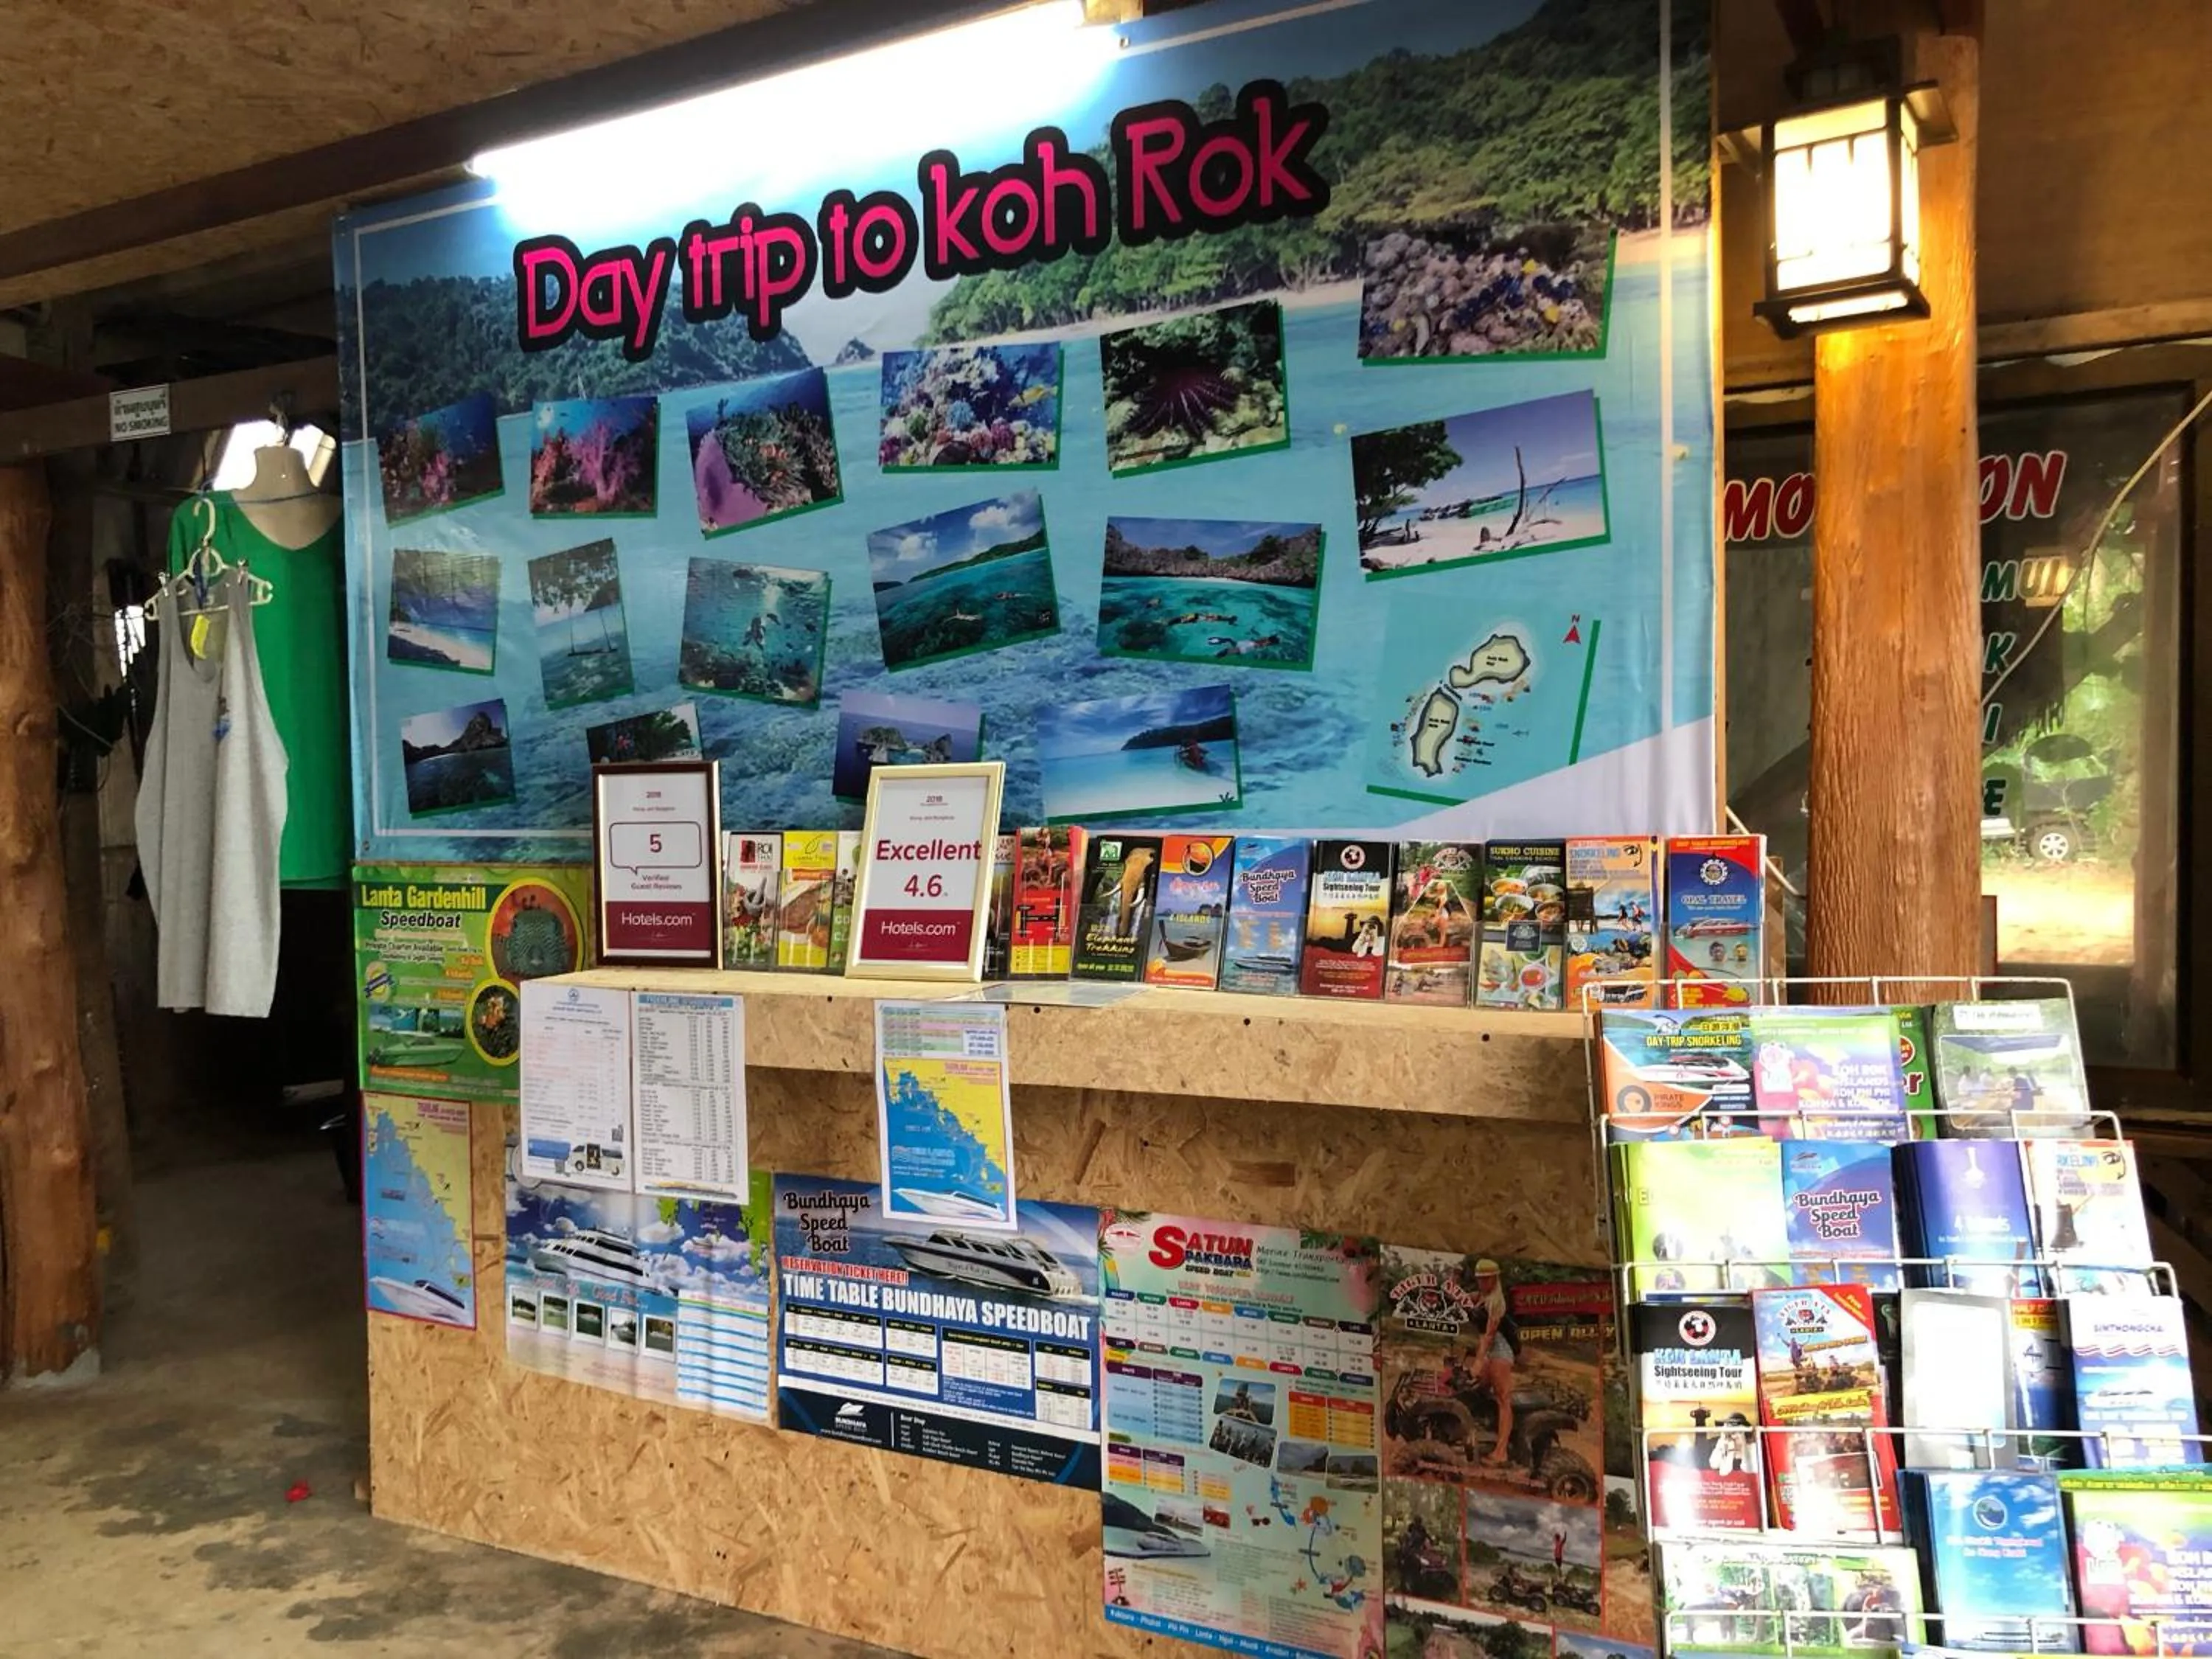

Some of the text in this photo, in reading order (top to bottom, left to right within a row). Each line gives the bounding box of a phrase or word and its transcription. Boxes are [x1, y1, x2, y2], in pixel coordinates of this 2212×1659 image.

[518, 88, 1321, 355] Day trip to koh Rok
[115, 415, 168, 433] NO SMOKING
[1571, 614, 1580, 623] N
[650, 834, 662, 853] 5
[876, 838, 982, 861] Excellent
[641, 874, 670, 882] Verified
[904, 874, 943, 897] 4.6
[1242, 871, 1295, 883] Bundhaya
[361, 884, 486, 910] Lanta Gardenhill
[1366, 884, 1381, 893] Tour
[380, 910, 462, 928] Speedboat
[622, 911, 693, 927] Hotels.com
[881, 921, 956, 936] Hotels.com
[1687, 1034, 1742, 1048] SNORKELING
[783, 1191, 871, 1213] Bundhaya
[1794, 1189, 1881, 1211] Bundhaya
[800, 1209, 848, 1237] Speed
[1812, 1207, 1859, 1228] Speed
[1820, 1221, 1860, 1239] Boat
[807, 1234, 849, 1252] Boat
[1149, 1225, 1253, 1270] SATUN
[1256, 1245, 1288, 1257] Marine
[782, 1256, 841, 1276] RESERVATION
[844, 1263, 875, 1281] TICKET
[1185, 1250, 1253, 1270] PAKBARA
[783, 1273, 1091, 1340] TIME TABLE BUNDHAYA SPEEDBOAT
[1519, 1326, 1563, 1342] OPEN
[1654, 1366, 1743, 1380] Sightseeing Tour
